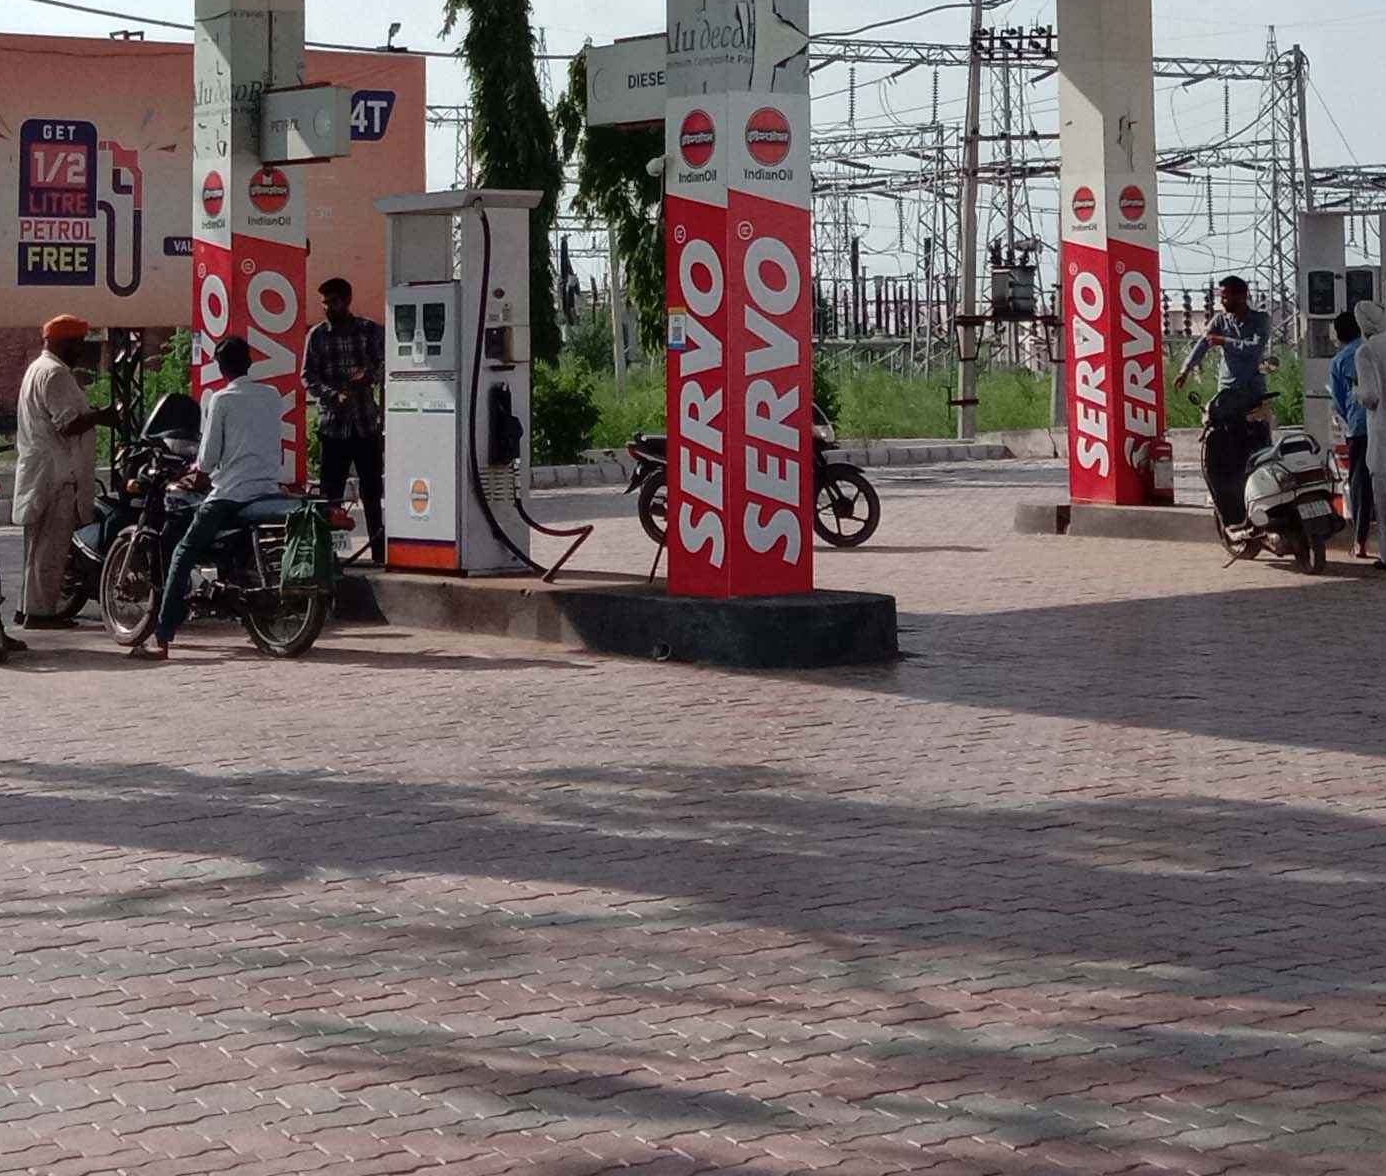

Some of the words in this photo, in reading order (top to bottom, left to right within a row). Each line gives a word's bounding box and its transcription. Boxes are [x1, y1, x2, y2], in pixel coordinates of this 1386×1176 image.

[627, 71, 665, 90] DIESE
[350, 99, 388, 134] 4T
[42, 125, 77, 141] GET
[34, 151, 87, 184] 1/2
[678, 169, 717, 184] IndianOil
[743, 168, 793, 182] IndianOil
[29, 192, 89, 215] LITRE
[19, 219, 97, 241] PETROL
[27, 246, 89, 272] FREE
[1072, 271, 1110, 478] SERVO
[679, 238, 725, 569] SERVO
[743, 236, 802, 566] SERVO
